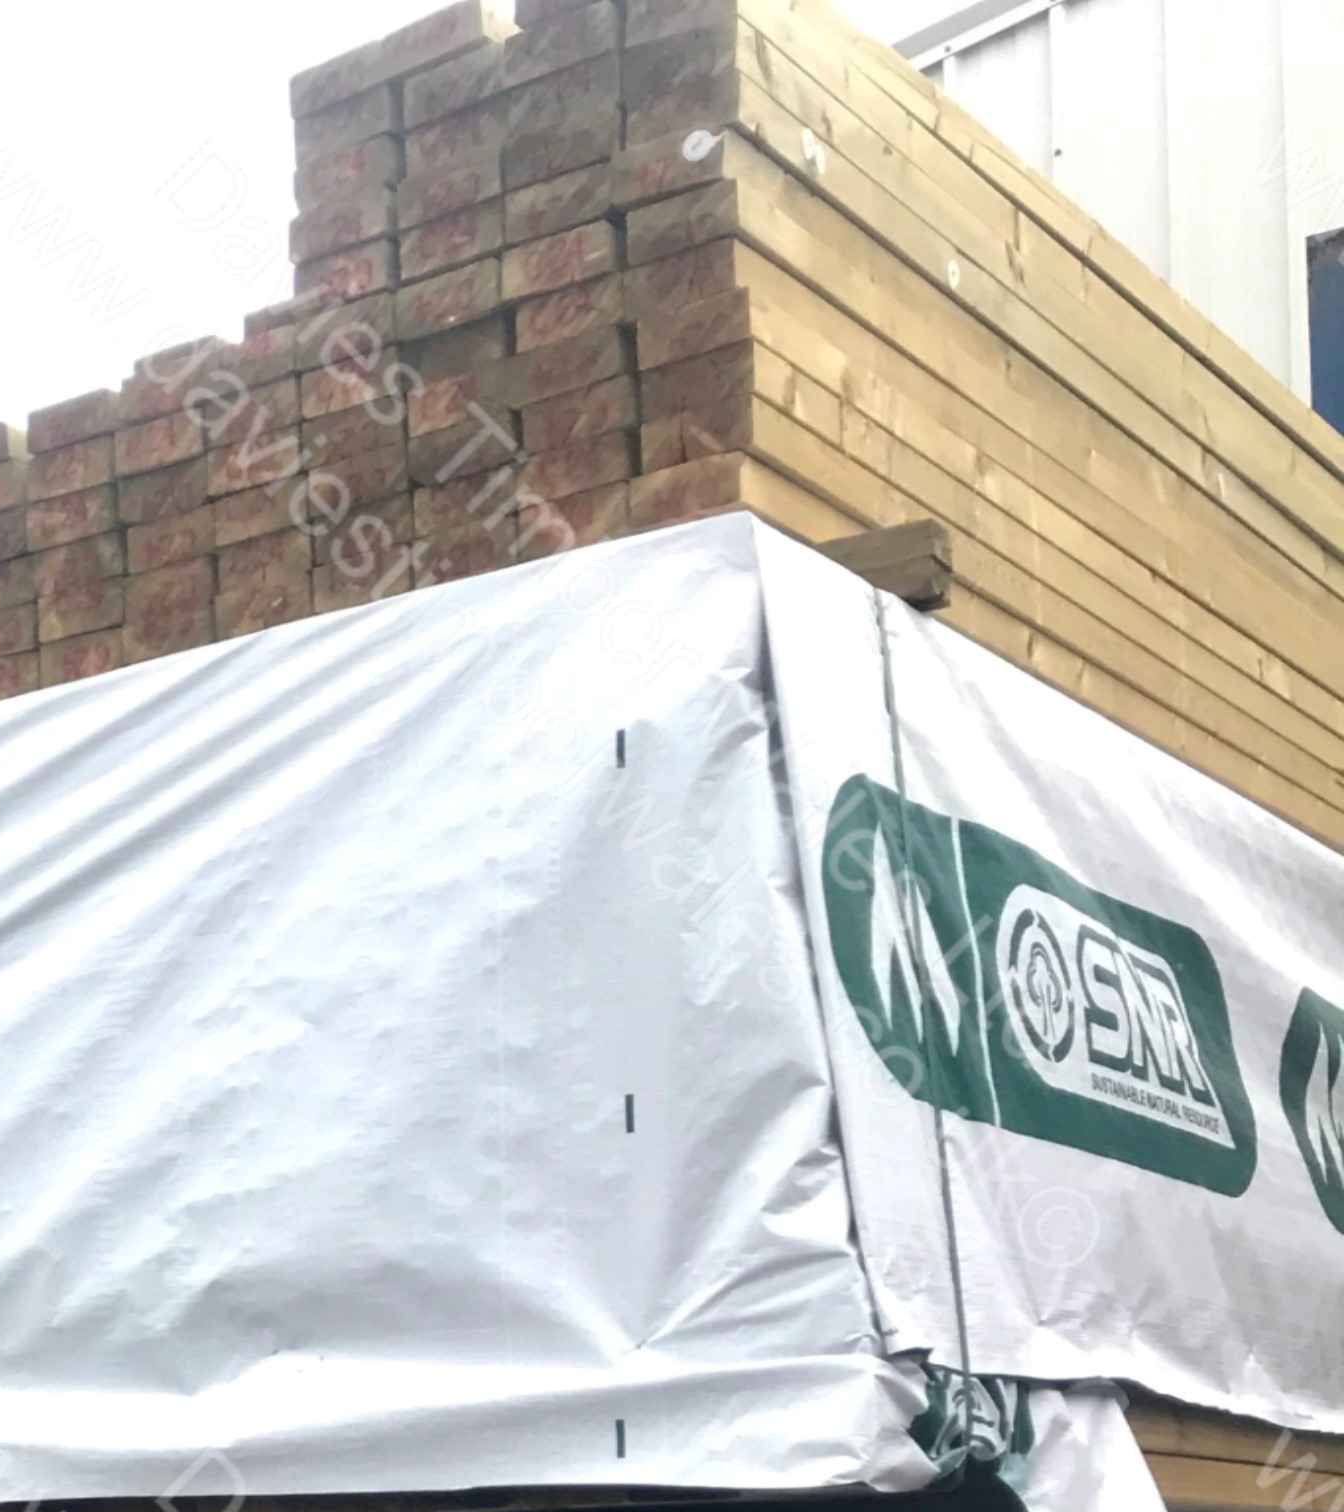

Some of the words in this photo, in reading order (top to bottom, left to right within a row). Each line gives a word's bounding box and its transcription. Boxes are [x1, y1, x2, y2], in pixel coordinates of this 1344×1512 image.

[1077, 925, 1213, 1107] SNR
[1091, 1072, 1146, 1107] SUSTAINABLE
[1147, 1092, 1182, 1120] NATURAL
[1182, 1105, 1220, 1135] RESOURCE
